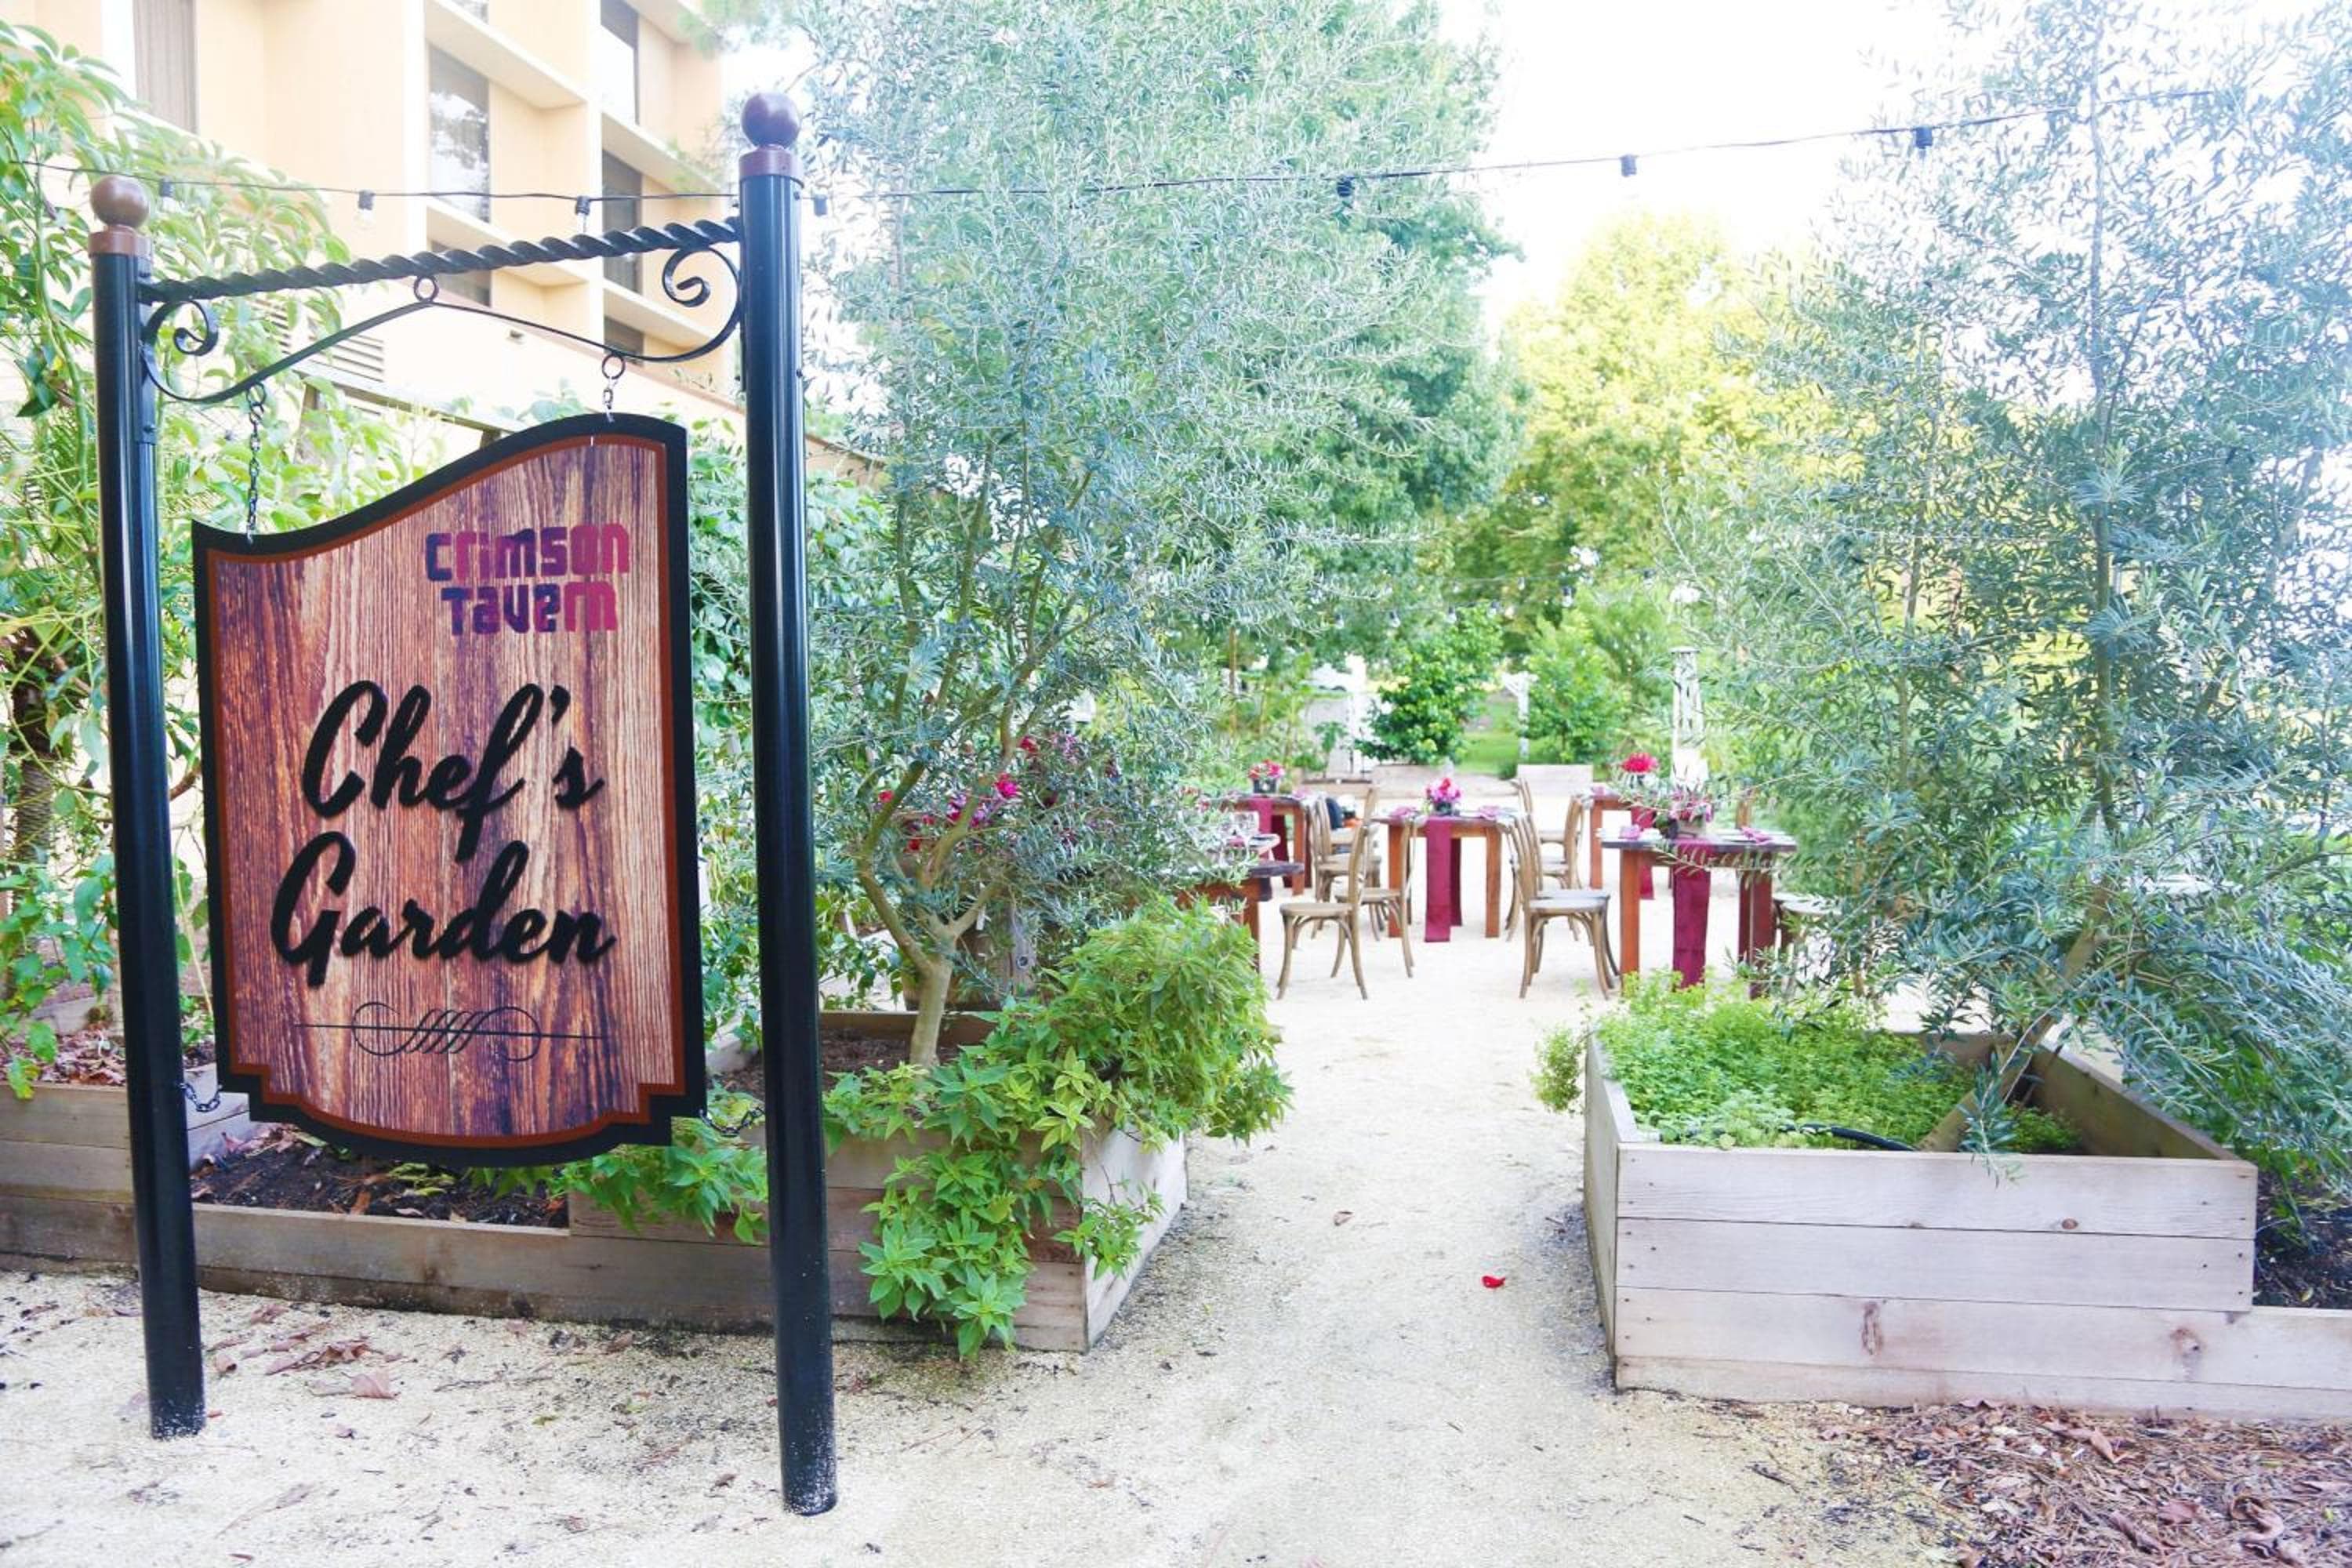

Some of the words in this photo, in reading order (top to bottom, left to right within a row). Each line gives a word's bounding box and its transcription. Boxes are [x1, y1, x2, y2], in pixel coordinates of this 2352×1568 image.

[441, 581, 618, 636] Tavern
[302, 680, 604, 862] Chef's
[270, 831, 616, 988] Garden
